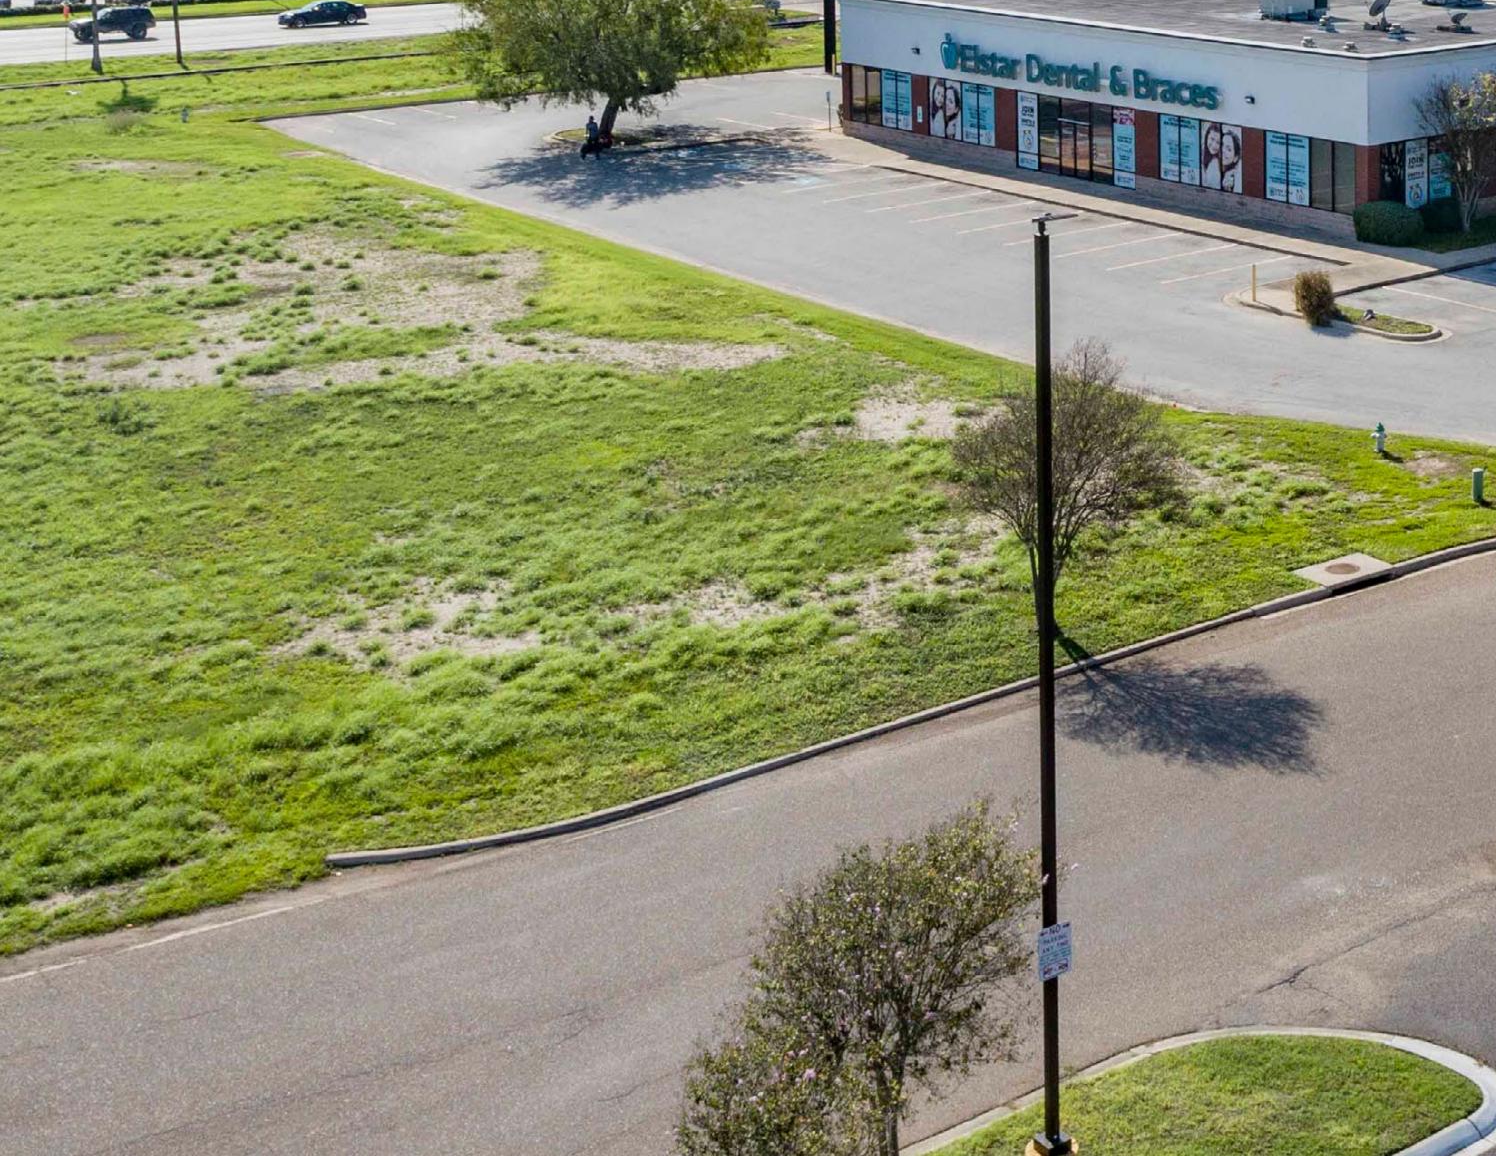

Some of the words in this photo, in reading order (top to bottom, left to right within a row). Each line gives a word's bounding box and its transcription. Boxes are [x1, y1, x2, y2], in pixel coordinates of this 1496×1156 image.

[960, 43, 1021, 81] Elstar
[1025, 53, 1100, 92] Dental
[1109, 64, 1130, 97] &
[1132, 68, 1221, 111] Braces
[1049, 923, 1061, 934] NO
